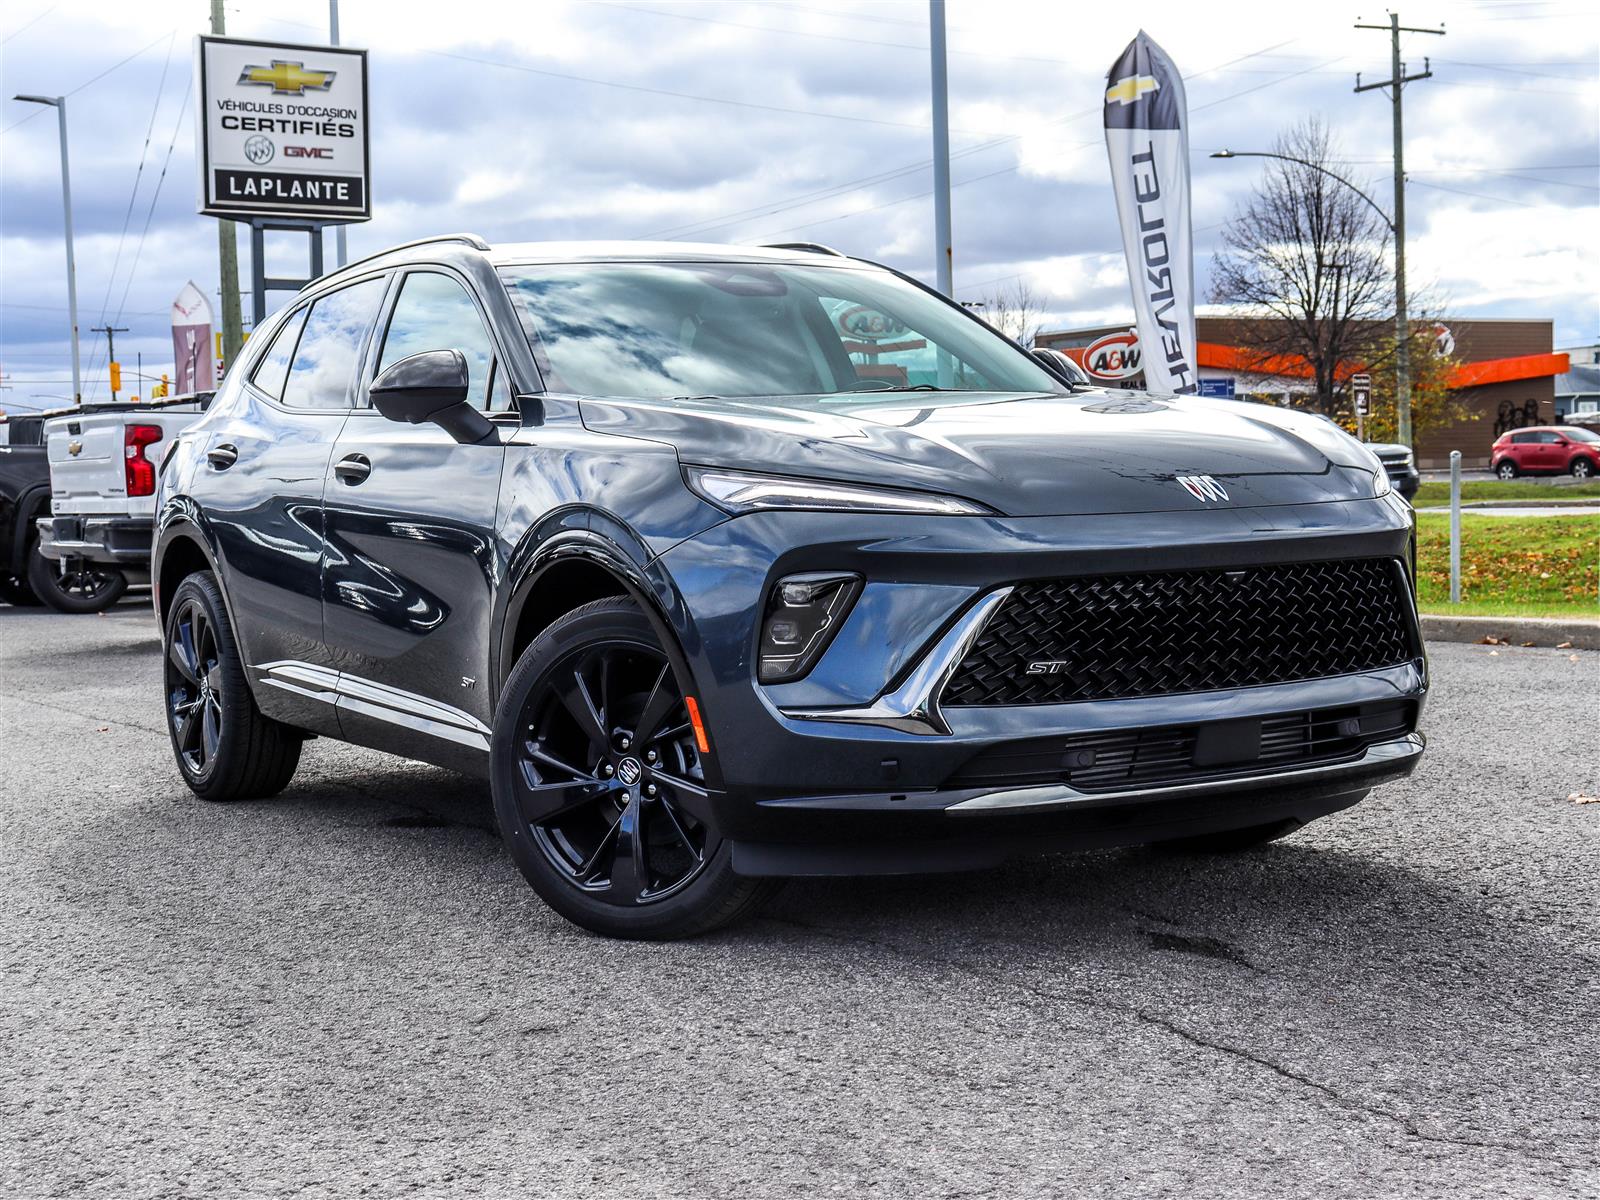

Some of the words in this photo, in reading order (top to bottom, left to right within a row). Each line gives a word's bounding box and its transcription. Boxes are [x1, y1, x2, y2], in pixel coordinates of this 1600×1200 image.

[217, 98, 283, 114] VÉHICULES
[287, 105, 357, 120] D'OCCASION
[221, 116, 355, 138] CERTIFIÉS
[284, 146, 334, 159] GMC
[229, 176, 349, 200] LAPLANTE
[1132, 140, 1197, 394] HEVROLET
[852, 315, 905, 333] A&W
[1093, 348, 1141, 371] A&W
[1025, 660, 1067, 674] ST
